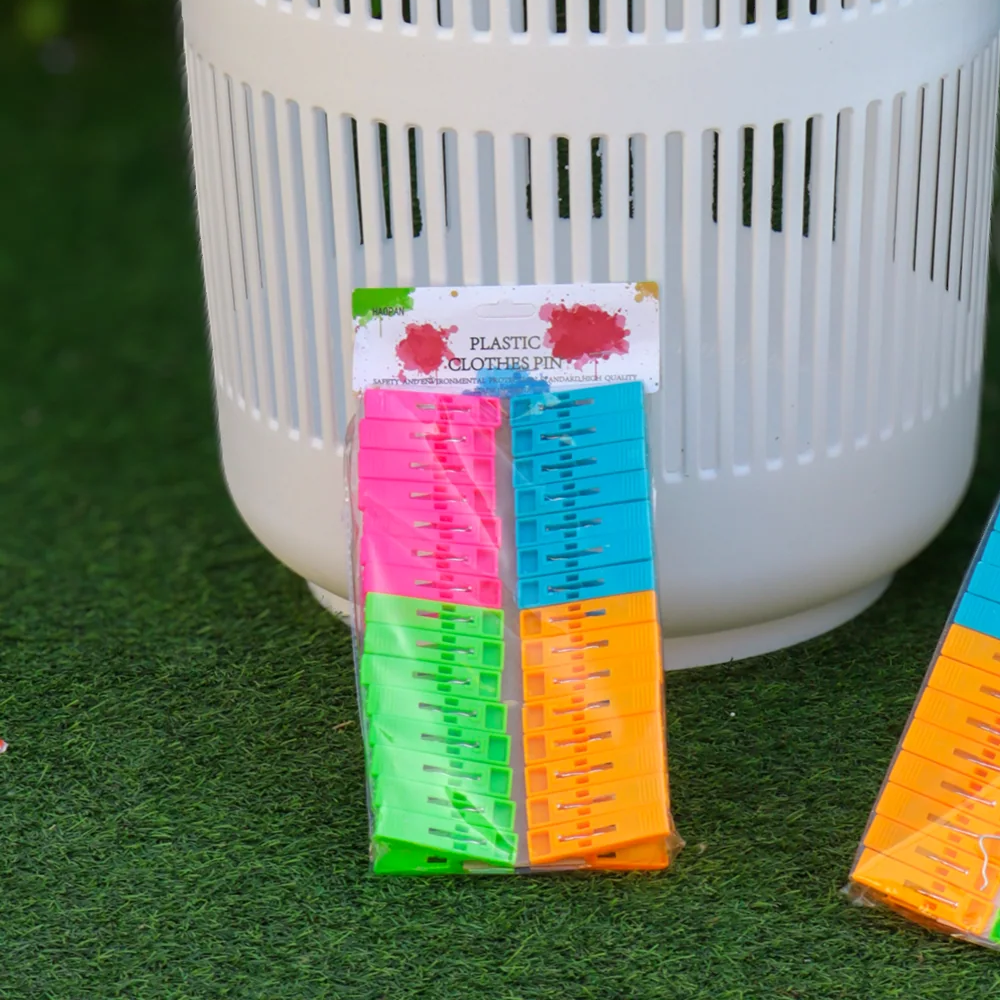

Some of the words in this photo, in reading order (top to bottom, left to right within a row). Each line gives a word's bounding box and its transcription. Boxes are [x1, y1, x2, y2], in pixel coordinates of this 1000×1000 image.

[469, 335, 542, 352] PLASTIC
[447, 356, 530, 372] CLOTHES
[533, 355, 564, 371] PIN
[372, 377, 400, 386] SAFETY
[604, 373, 638, 382] QUALITY
